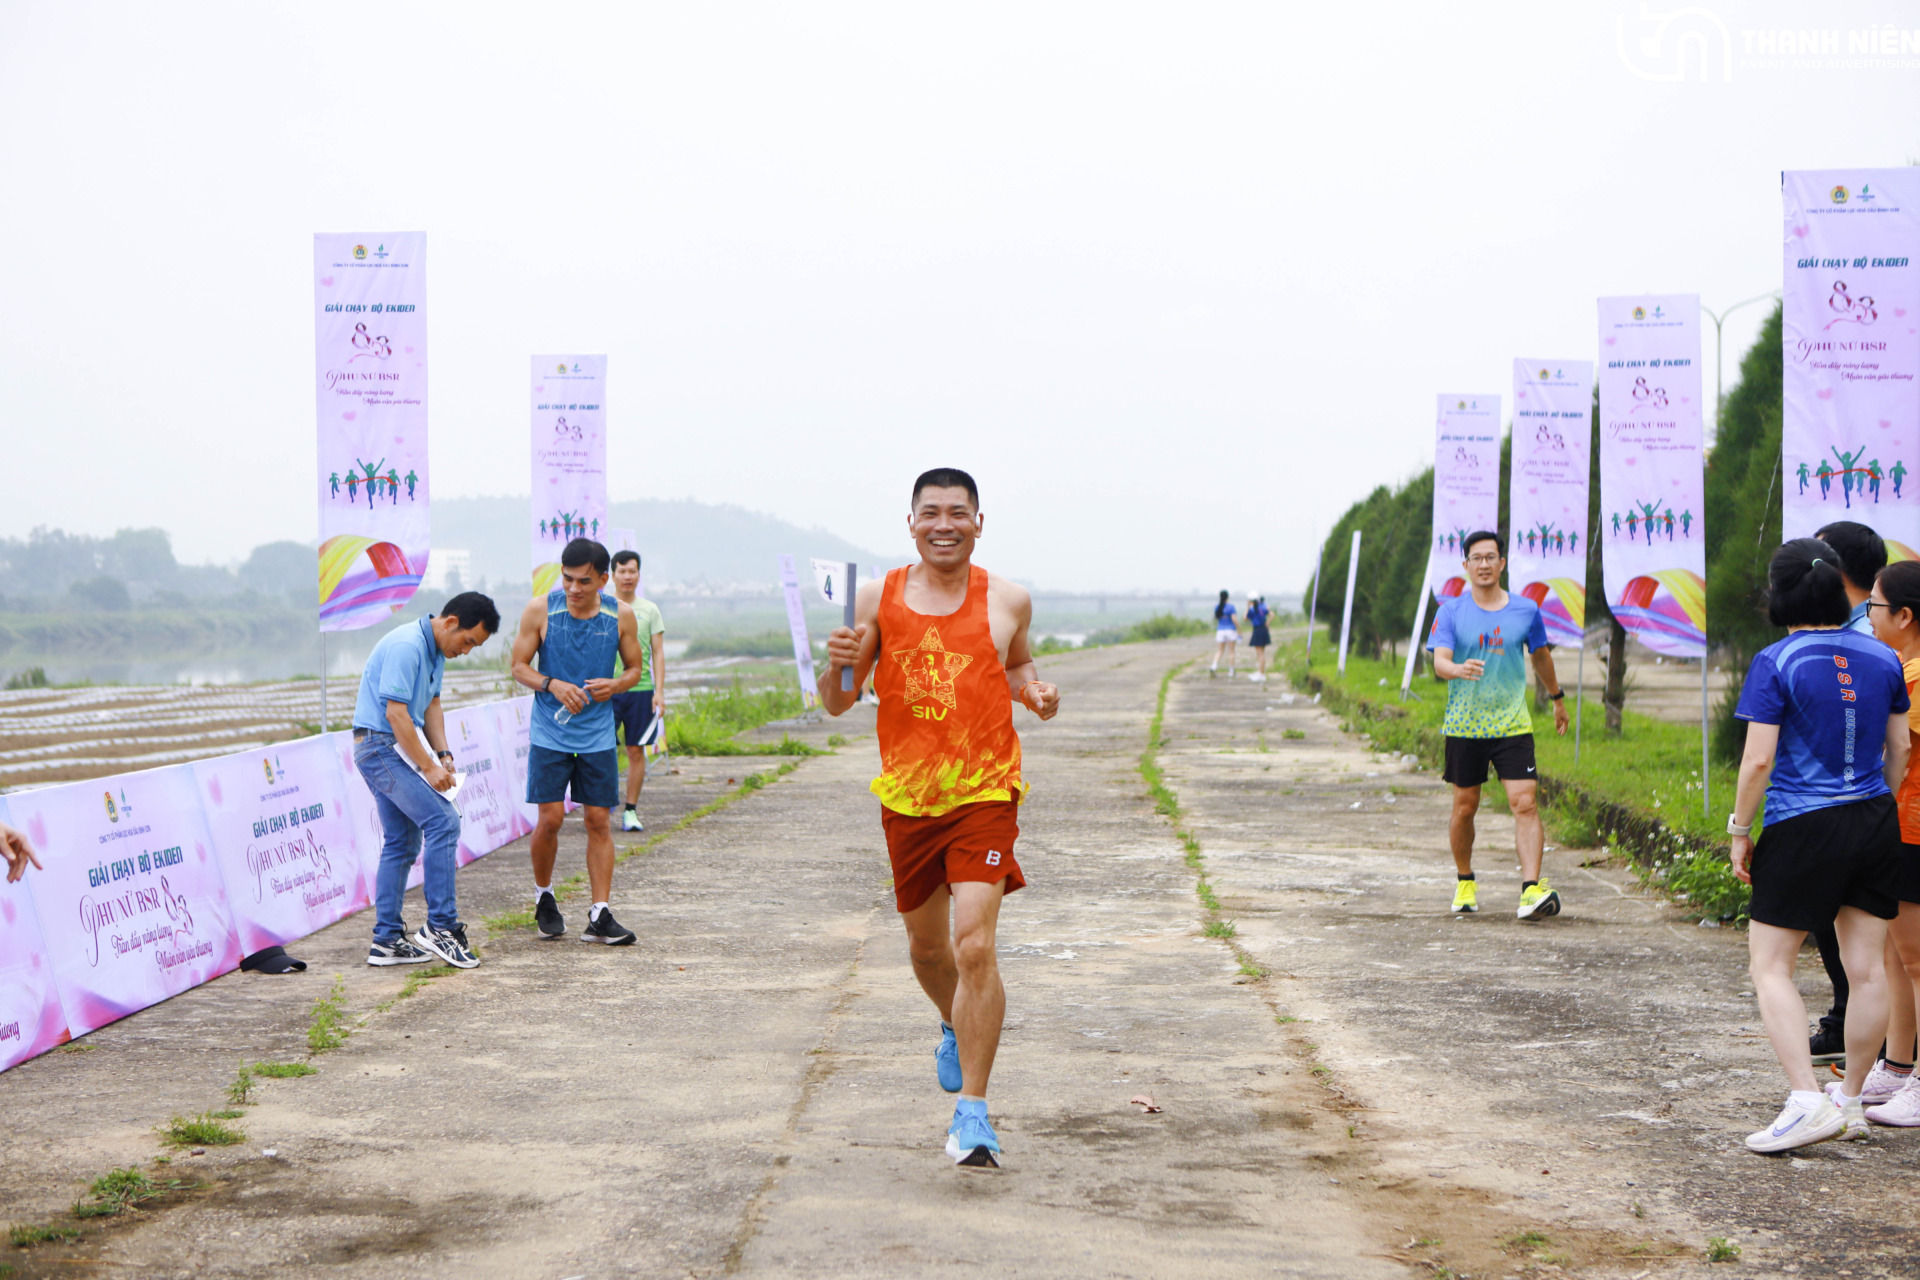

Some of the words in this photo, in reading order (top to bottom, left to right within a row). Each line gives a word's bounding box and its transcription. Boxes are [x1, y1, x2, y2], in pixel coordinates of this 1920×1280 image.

[1871, 257, 1909, 268] EKIDEN
[386, 304, 416, 313] EKIDEN
[824, 574, 833, 600] 4
[1844, 707, 1855, 763] RUNNERS
[300, 803, 325, 823] EKIDEN
[111, 857, 135, 881] CHẠY
[138, 849, 151, 875] BỘ
[153, 845, 183, 869] EKIDEN
[135, 887, 161, 913] BSR
